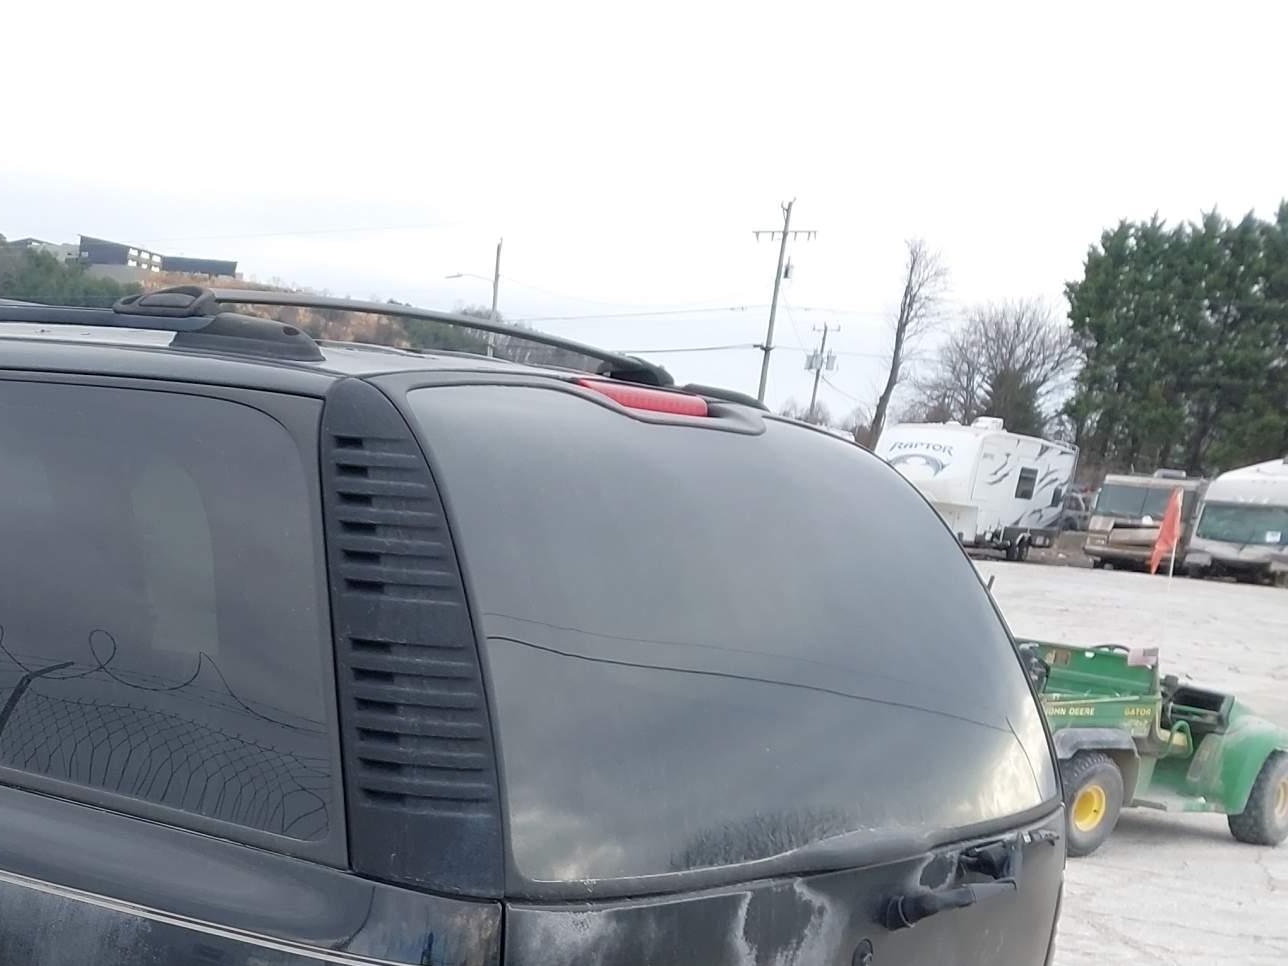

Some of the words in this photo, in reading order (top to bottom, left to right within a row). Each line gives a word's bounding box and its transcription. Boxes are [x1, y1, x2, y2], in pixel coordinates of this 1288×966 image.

[889, 440, 954, 457] RAPTOR
[1068, 706, 1095, 716] DEERE
[1123, 706, 1152, 717] GATOR
